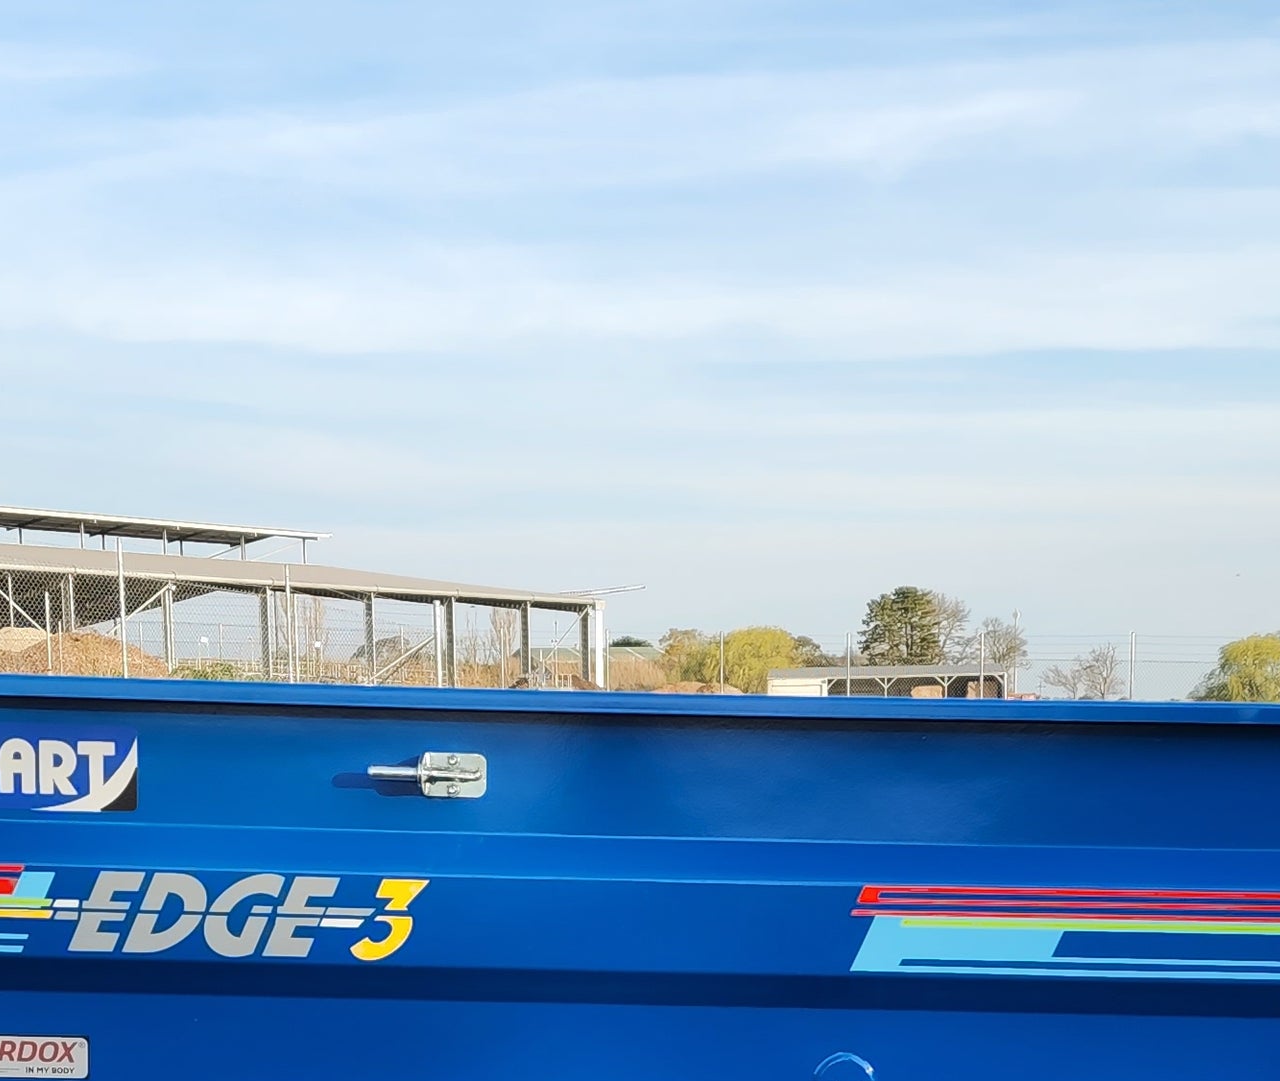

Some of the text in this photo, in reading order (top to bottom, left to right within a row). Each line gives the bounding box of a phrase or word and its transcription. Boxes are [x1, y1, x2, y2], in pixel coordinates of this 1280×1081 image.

[25, 1066, 35, 1074] IN
[36, 1066, 50, 1074] MY
[51, 1067, 75, 1075] BODY
